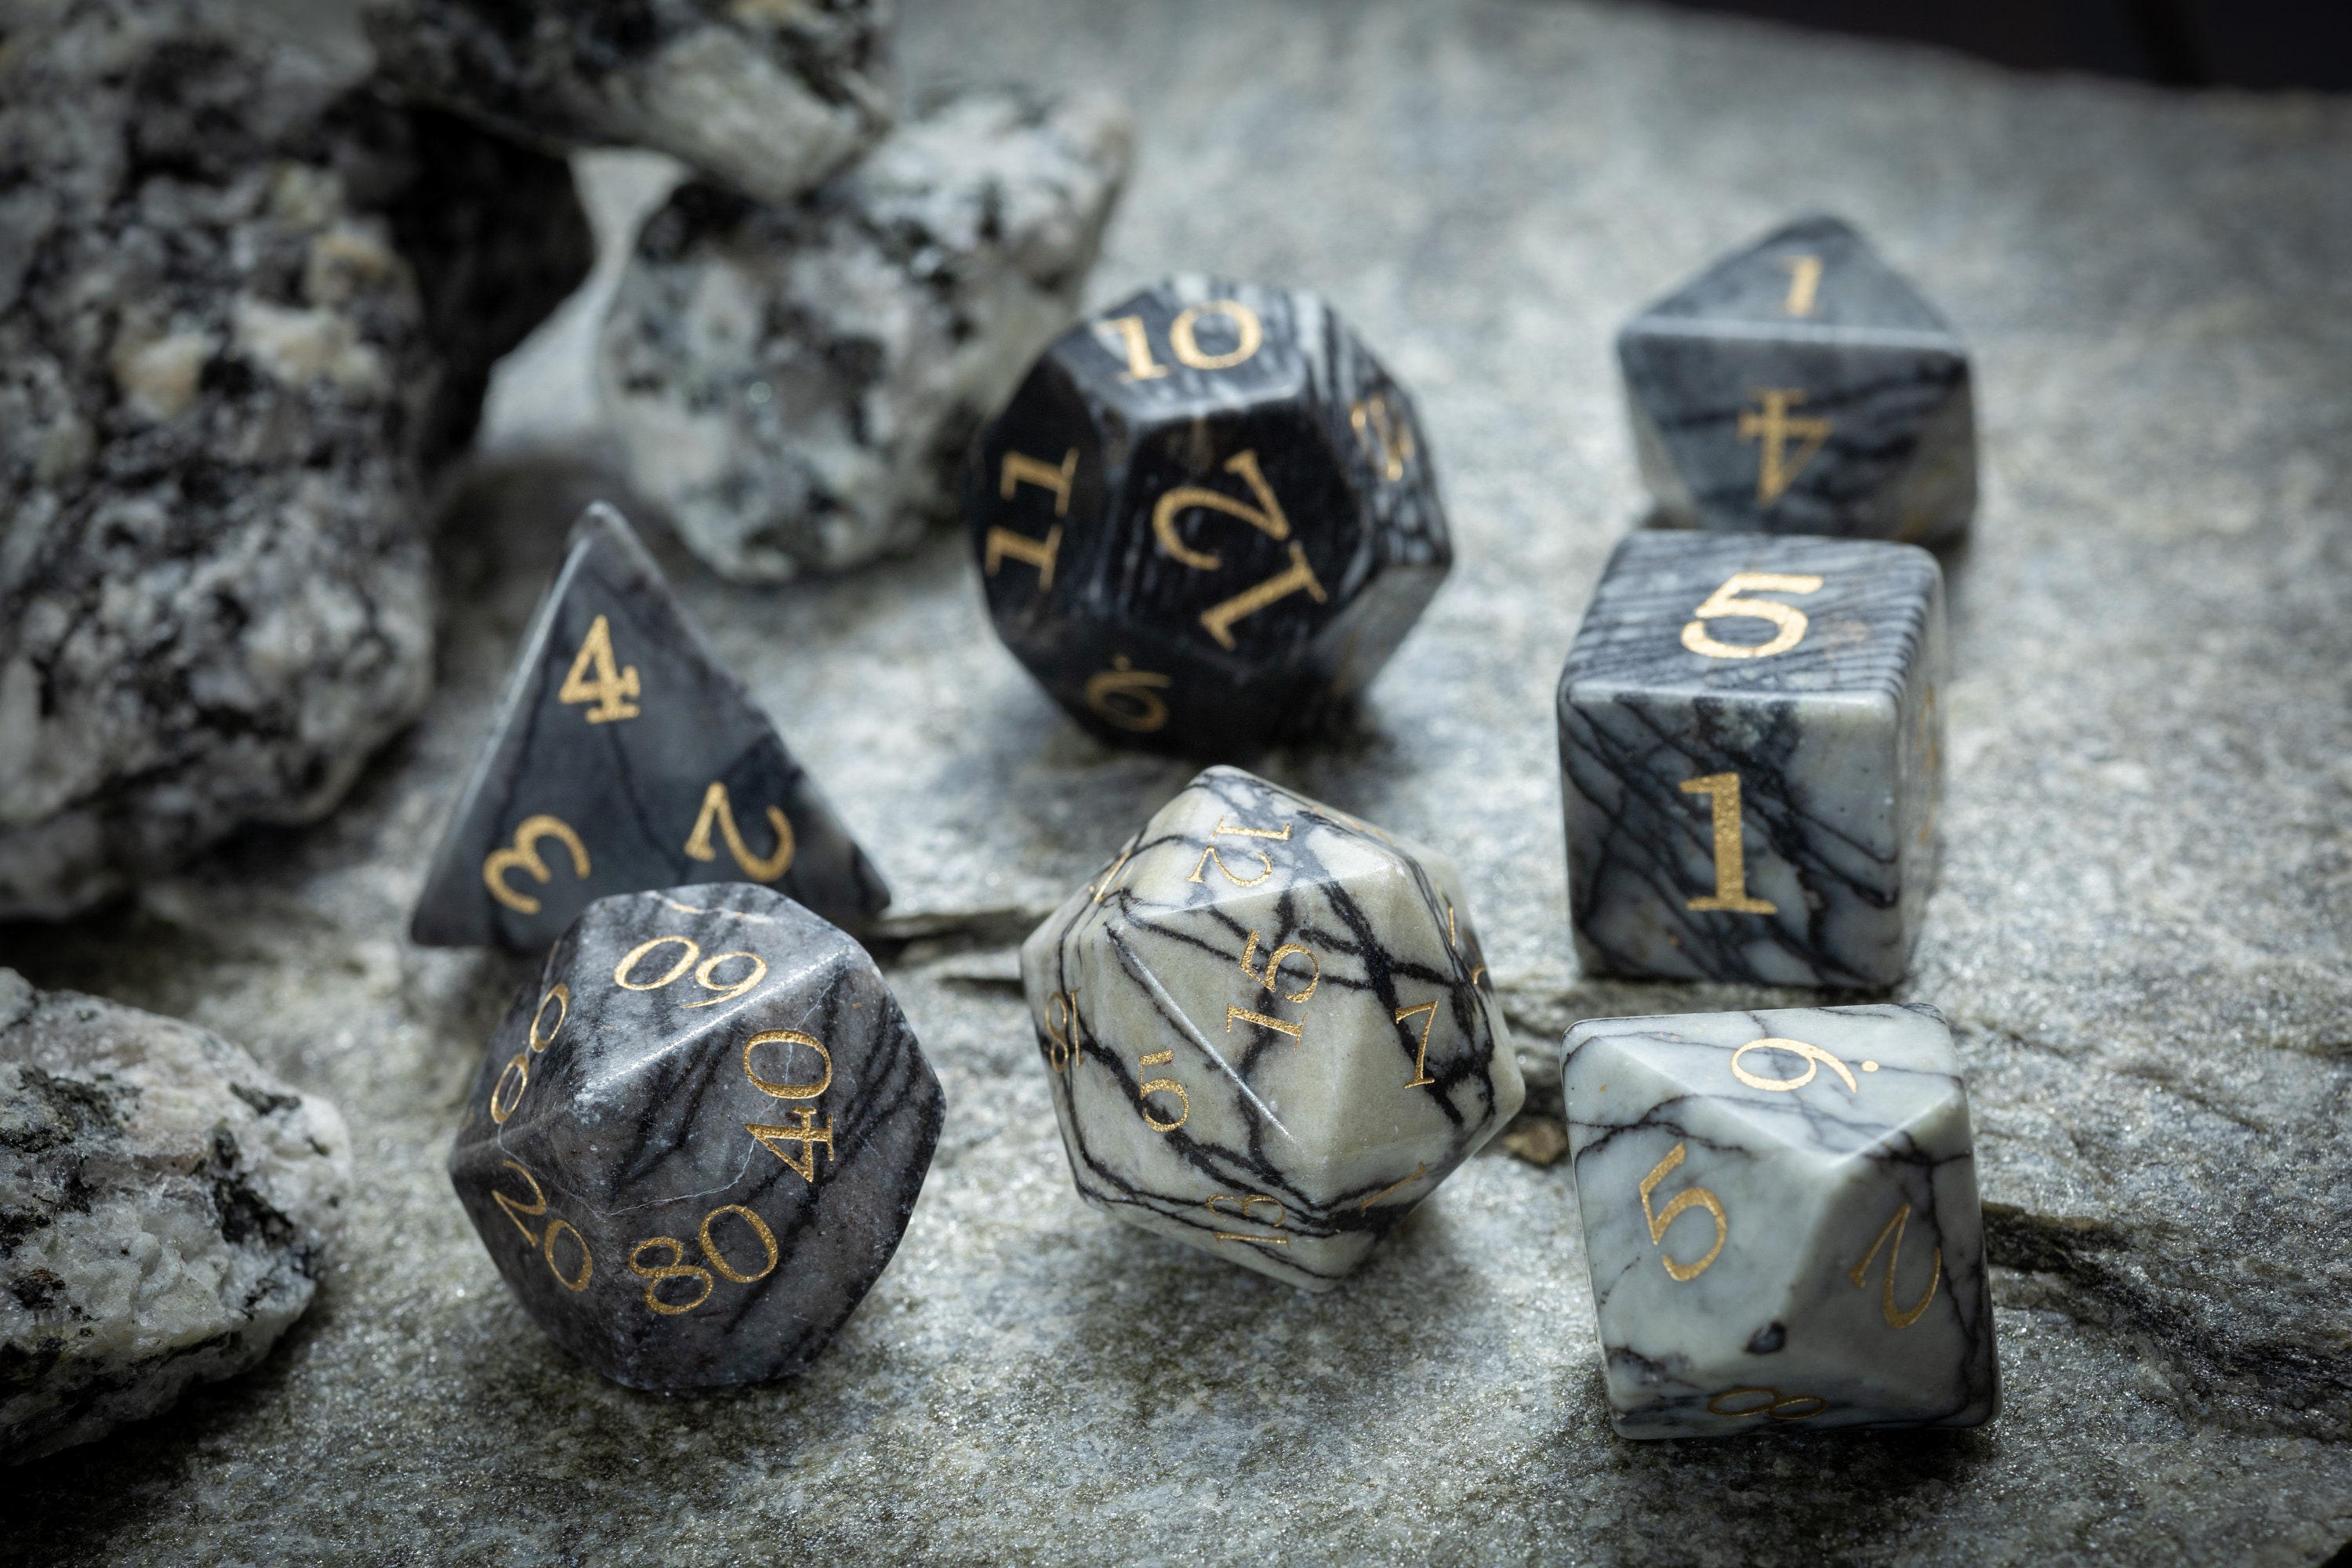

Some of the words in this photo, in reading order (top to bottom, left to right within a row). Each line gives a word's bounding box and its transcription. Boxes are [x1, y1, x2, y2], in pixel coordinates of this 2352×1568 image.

[1094, 298, 1262, 381] 10
[1780, 252, 1827, 318] 1
[1736, 389, 1836, 508] 4
[985, 447, 1080, 593] 11
[1151, 448, 1328, 652] 12
[557, 614, 641, 724] 4
[1679, 572, 1824, 659] 5
[482, 815, 591, 915] 3
[684, 781, 795, 883] 2
[1186, 815, 1291, 888] 12
[1678, 771, 1777, 914] 1
[1226, 928, 1320, 1054] 15
[1396, 1000, 1439, 1090] 7
[742, 1029, 835, 1183] 40
[1138, 1049, 1190, 1133] 5
[491, 1160, 593, 1293] 20
[629, 1204, 778, 1316] 80
[1205, 1192, 1292, 1254] 13
[1639, 1141, 1727, 1282] 5
[1848, 1203, 1942, 1330] 2
[1707, 1386, 1829, 1421] 8
